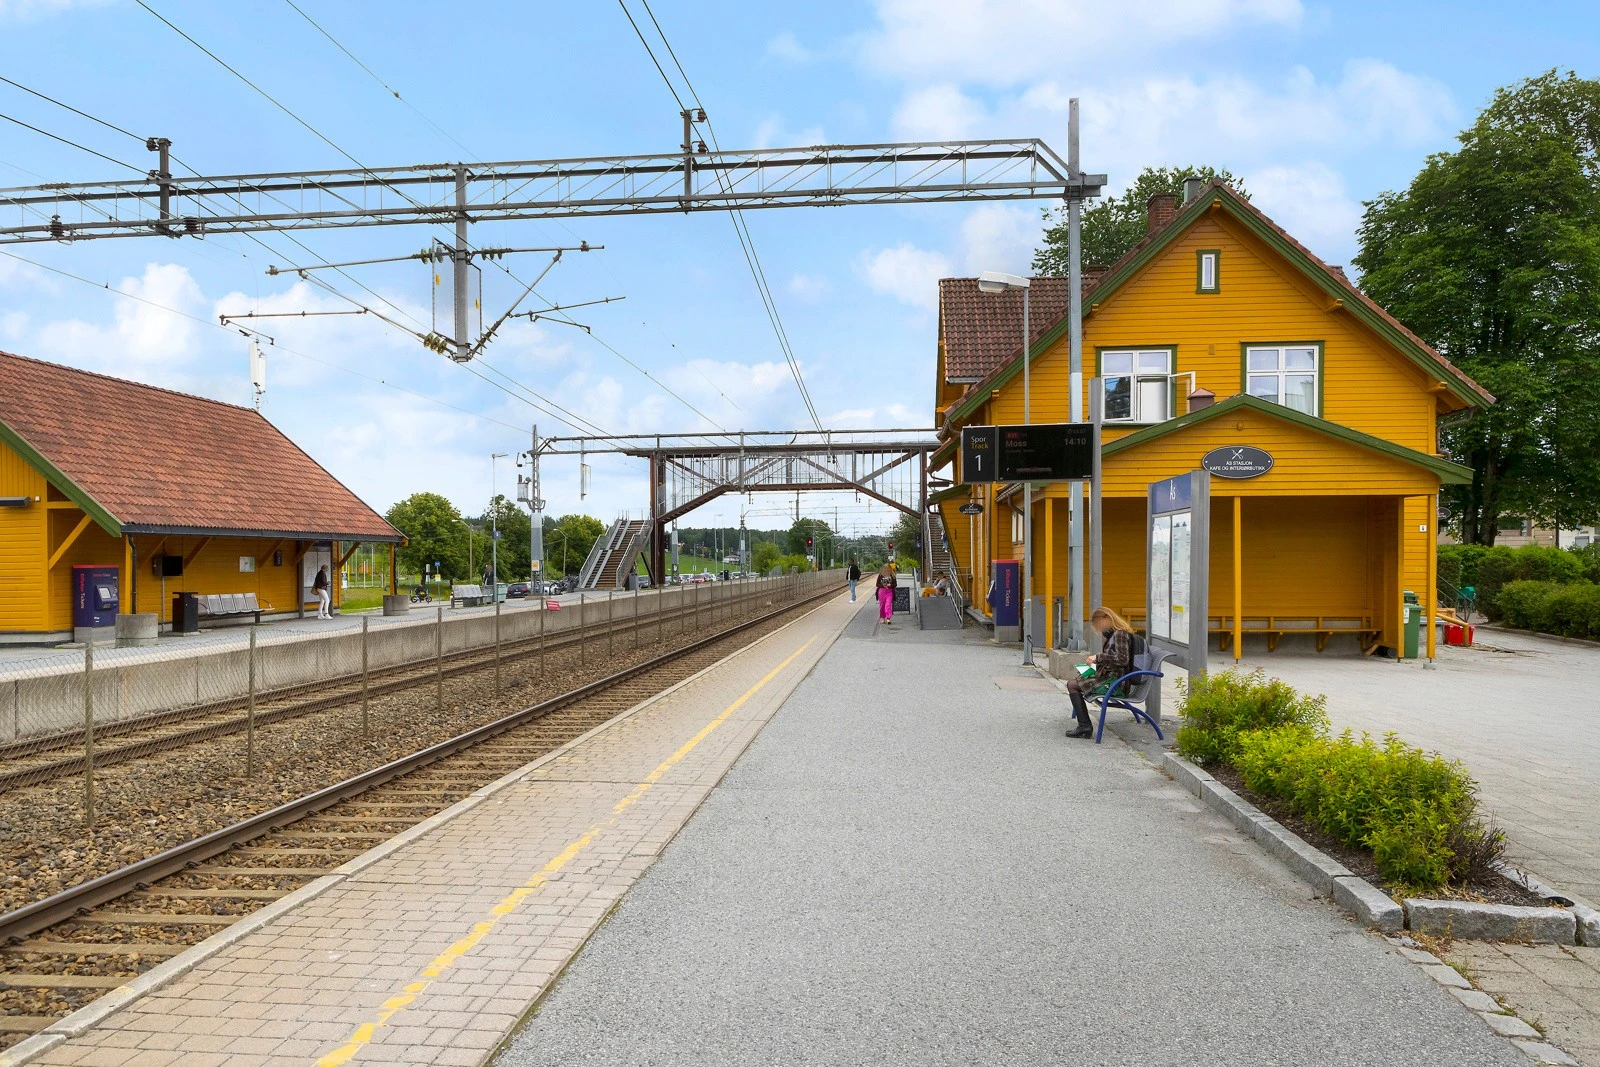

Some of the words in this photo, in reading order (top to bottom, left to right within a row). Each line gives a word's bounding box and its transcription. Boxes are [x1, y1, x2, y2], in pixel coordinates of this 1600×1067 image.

[970, 435, 987, 444] Spor
[1005, 439, 1027, 447] Moss
[974, 454, 981, 471] 1
